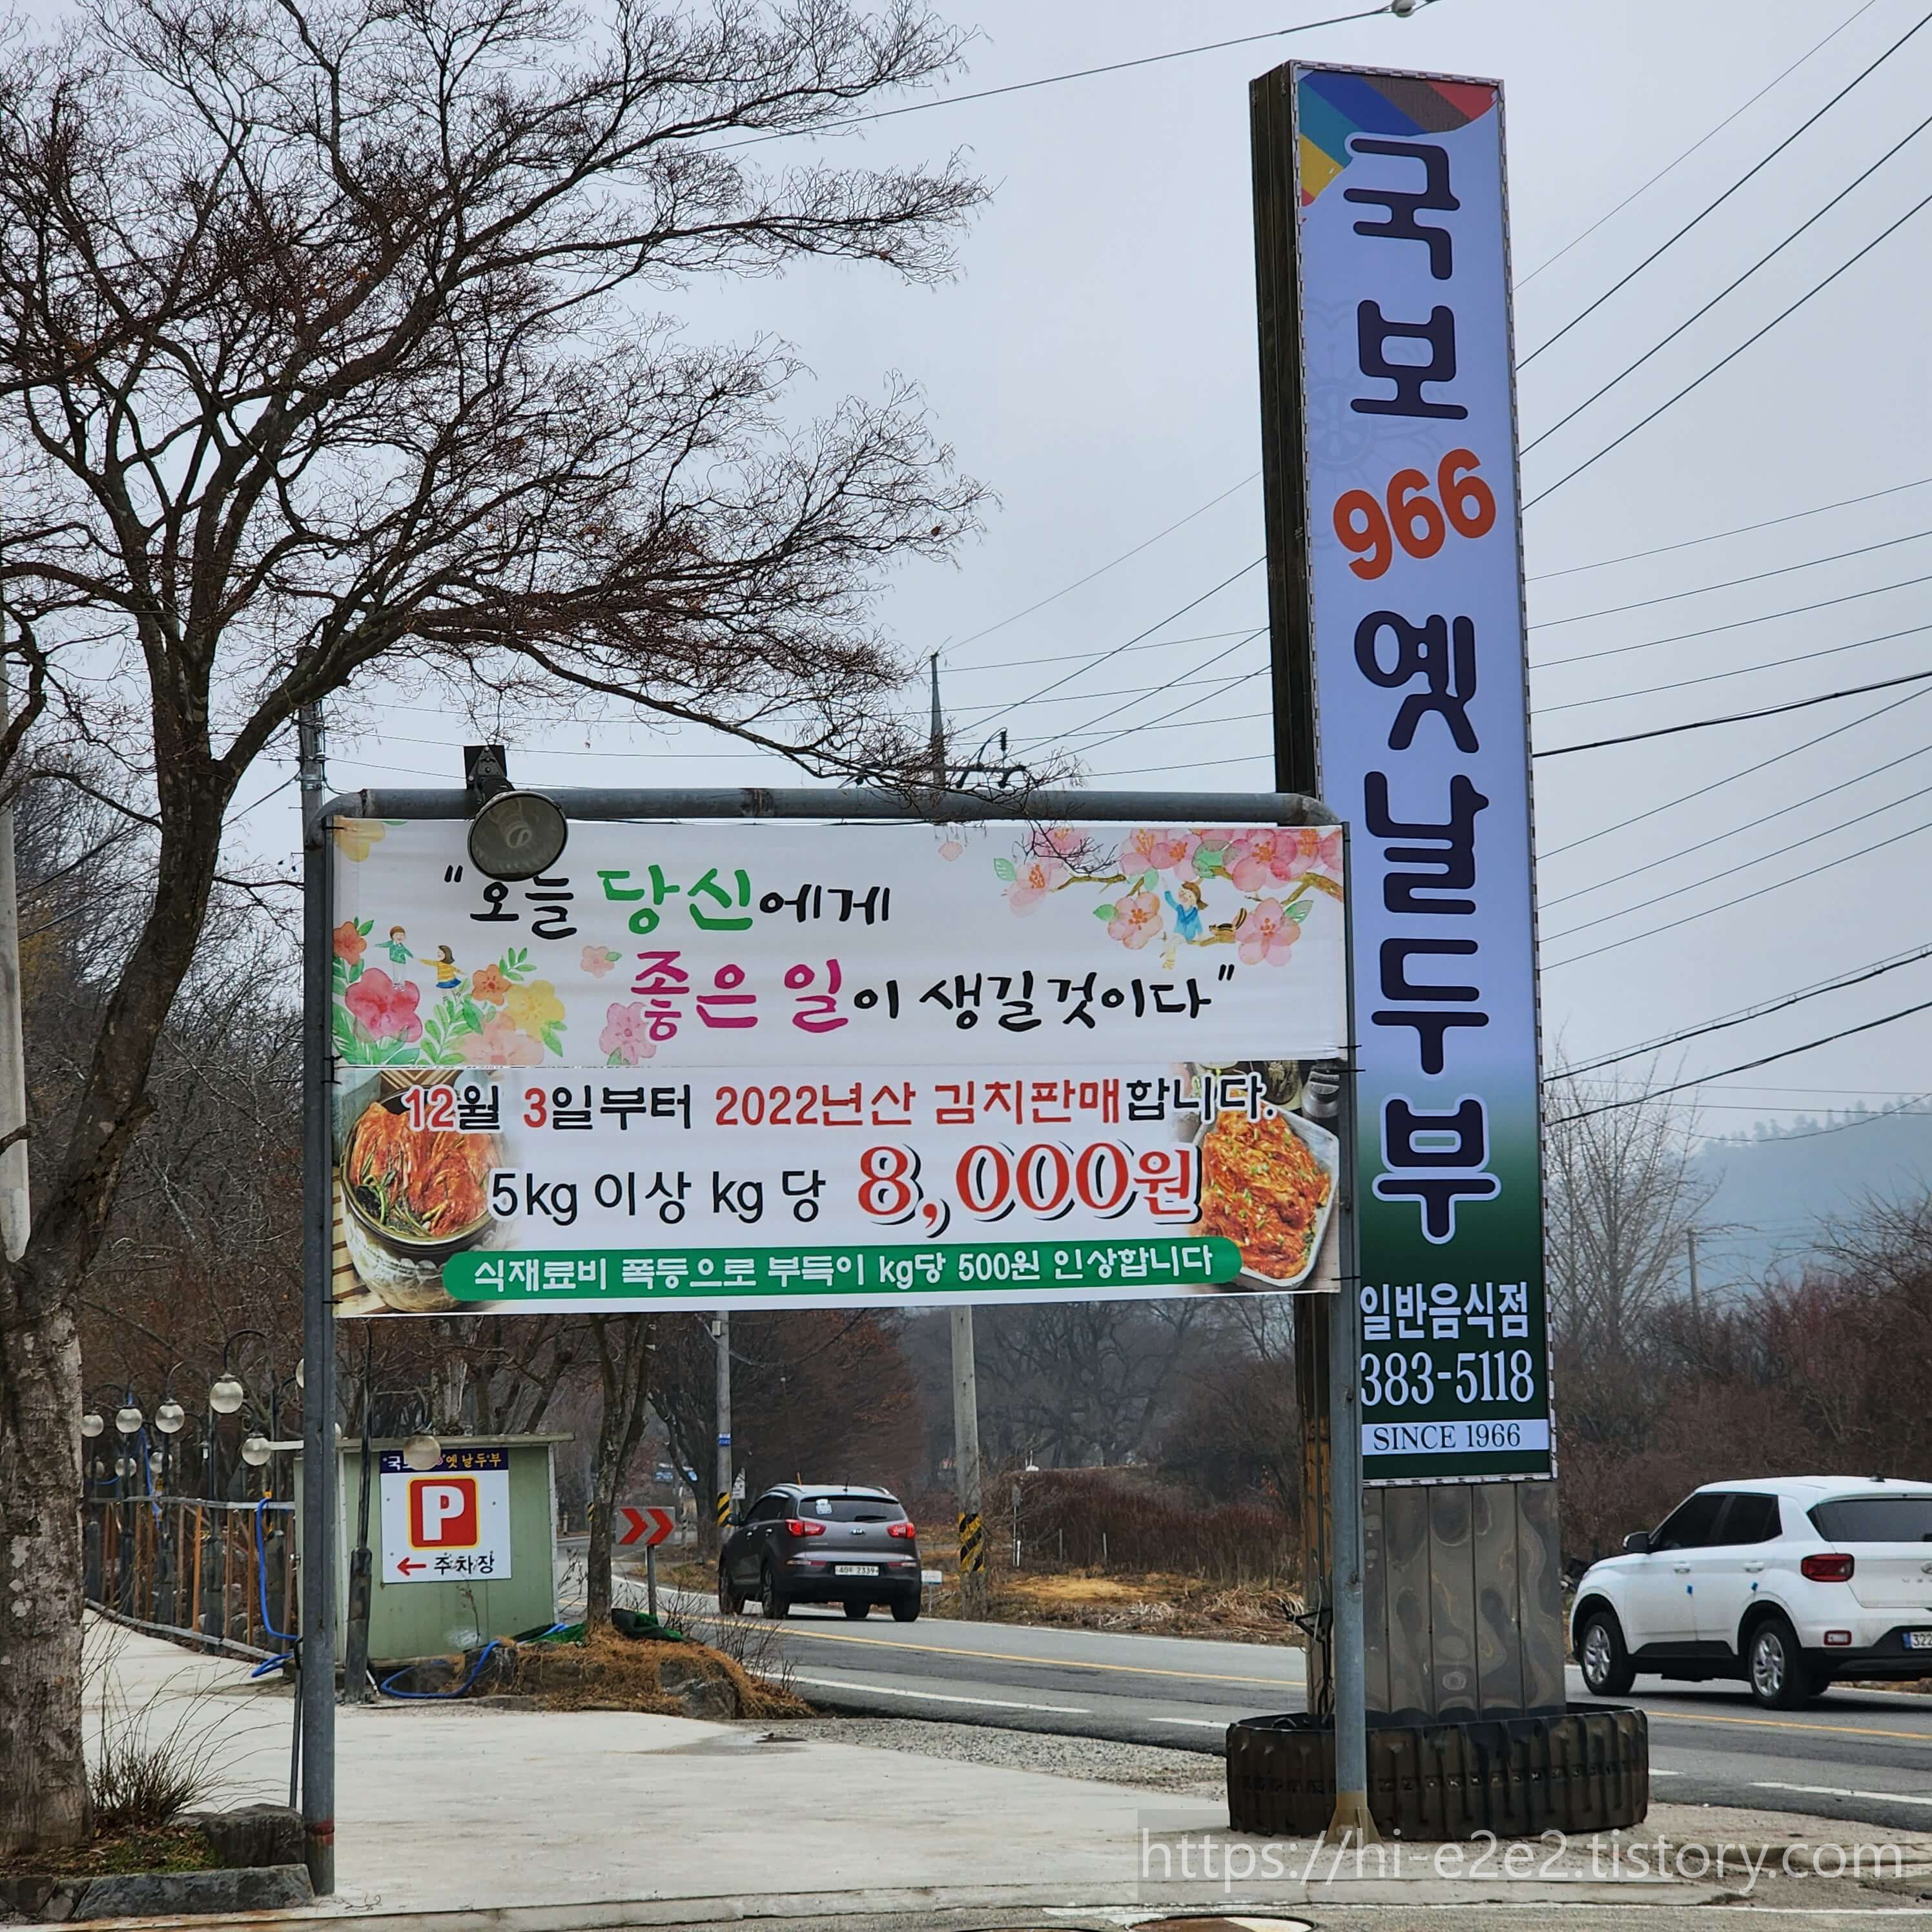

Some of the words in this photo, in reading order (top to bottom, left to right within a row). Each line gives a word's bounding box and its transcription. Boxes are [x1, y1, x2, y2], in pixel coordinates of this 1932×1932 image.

[1343, 138, 1468, 420] 국보
[1332, 447, 1497, 581] 966
[597, 864, 890, 934] 당신에게
[1353, 610, 1496, 1238] 옛날두부
[631, 951, 758, 1042] 좋은
[784, 959, 898, 1033] 일이
[405, 1085, 500, 1130] 12월
[523, 1085, 692, 1131] 3일부터
[715, 1080, 916, 1126] 2022년산
[934, 1074, 1277, 1124] 김치판매합니다.
[491, 1172, 578, 1226] 5kg
[594, 1171, 692, 1224] 이상
[712, 1171, 763, 1222] kg
[781, 1169, 826, 1222] 당
[858, 1143, 1202, 1237] 8,000원
[474, 1257, 608, 1292] 식재료비
[622, 1255, 756, 1289] 폭등으로
[768, 1253, 865, 1287] 부득이
[879, 1253, 945, 1287] kg당
[958, 1251, 1040, 1283] 500원
[1054, 1247, 1212, 1279] 인상합니다
[1360, 1281, 1528, 1341] 일반음식점
[1360, 1349, 1534, 1406] 383-5118
[446, 1453, 502, 1468] 옛날두부
[1373, 1424, 1457, 1451] SINCE
[1466, 1423, 1521, 1448] 1966
[422, 1485, 465, 1541] P
[433, 1555, 495, 1576] 주차장
